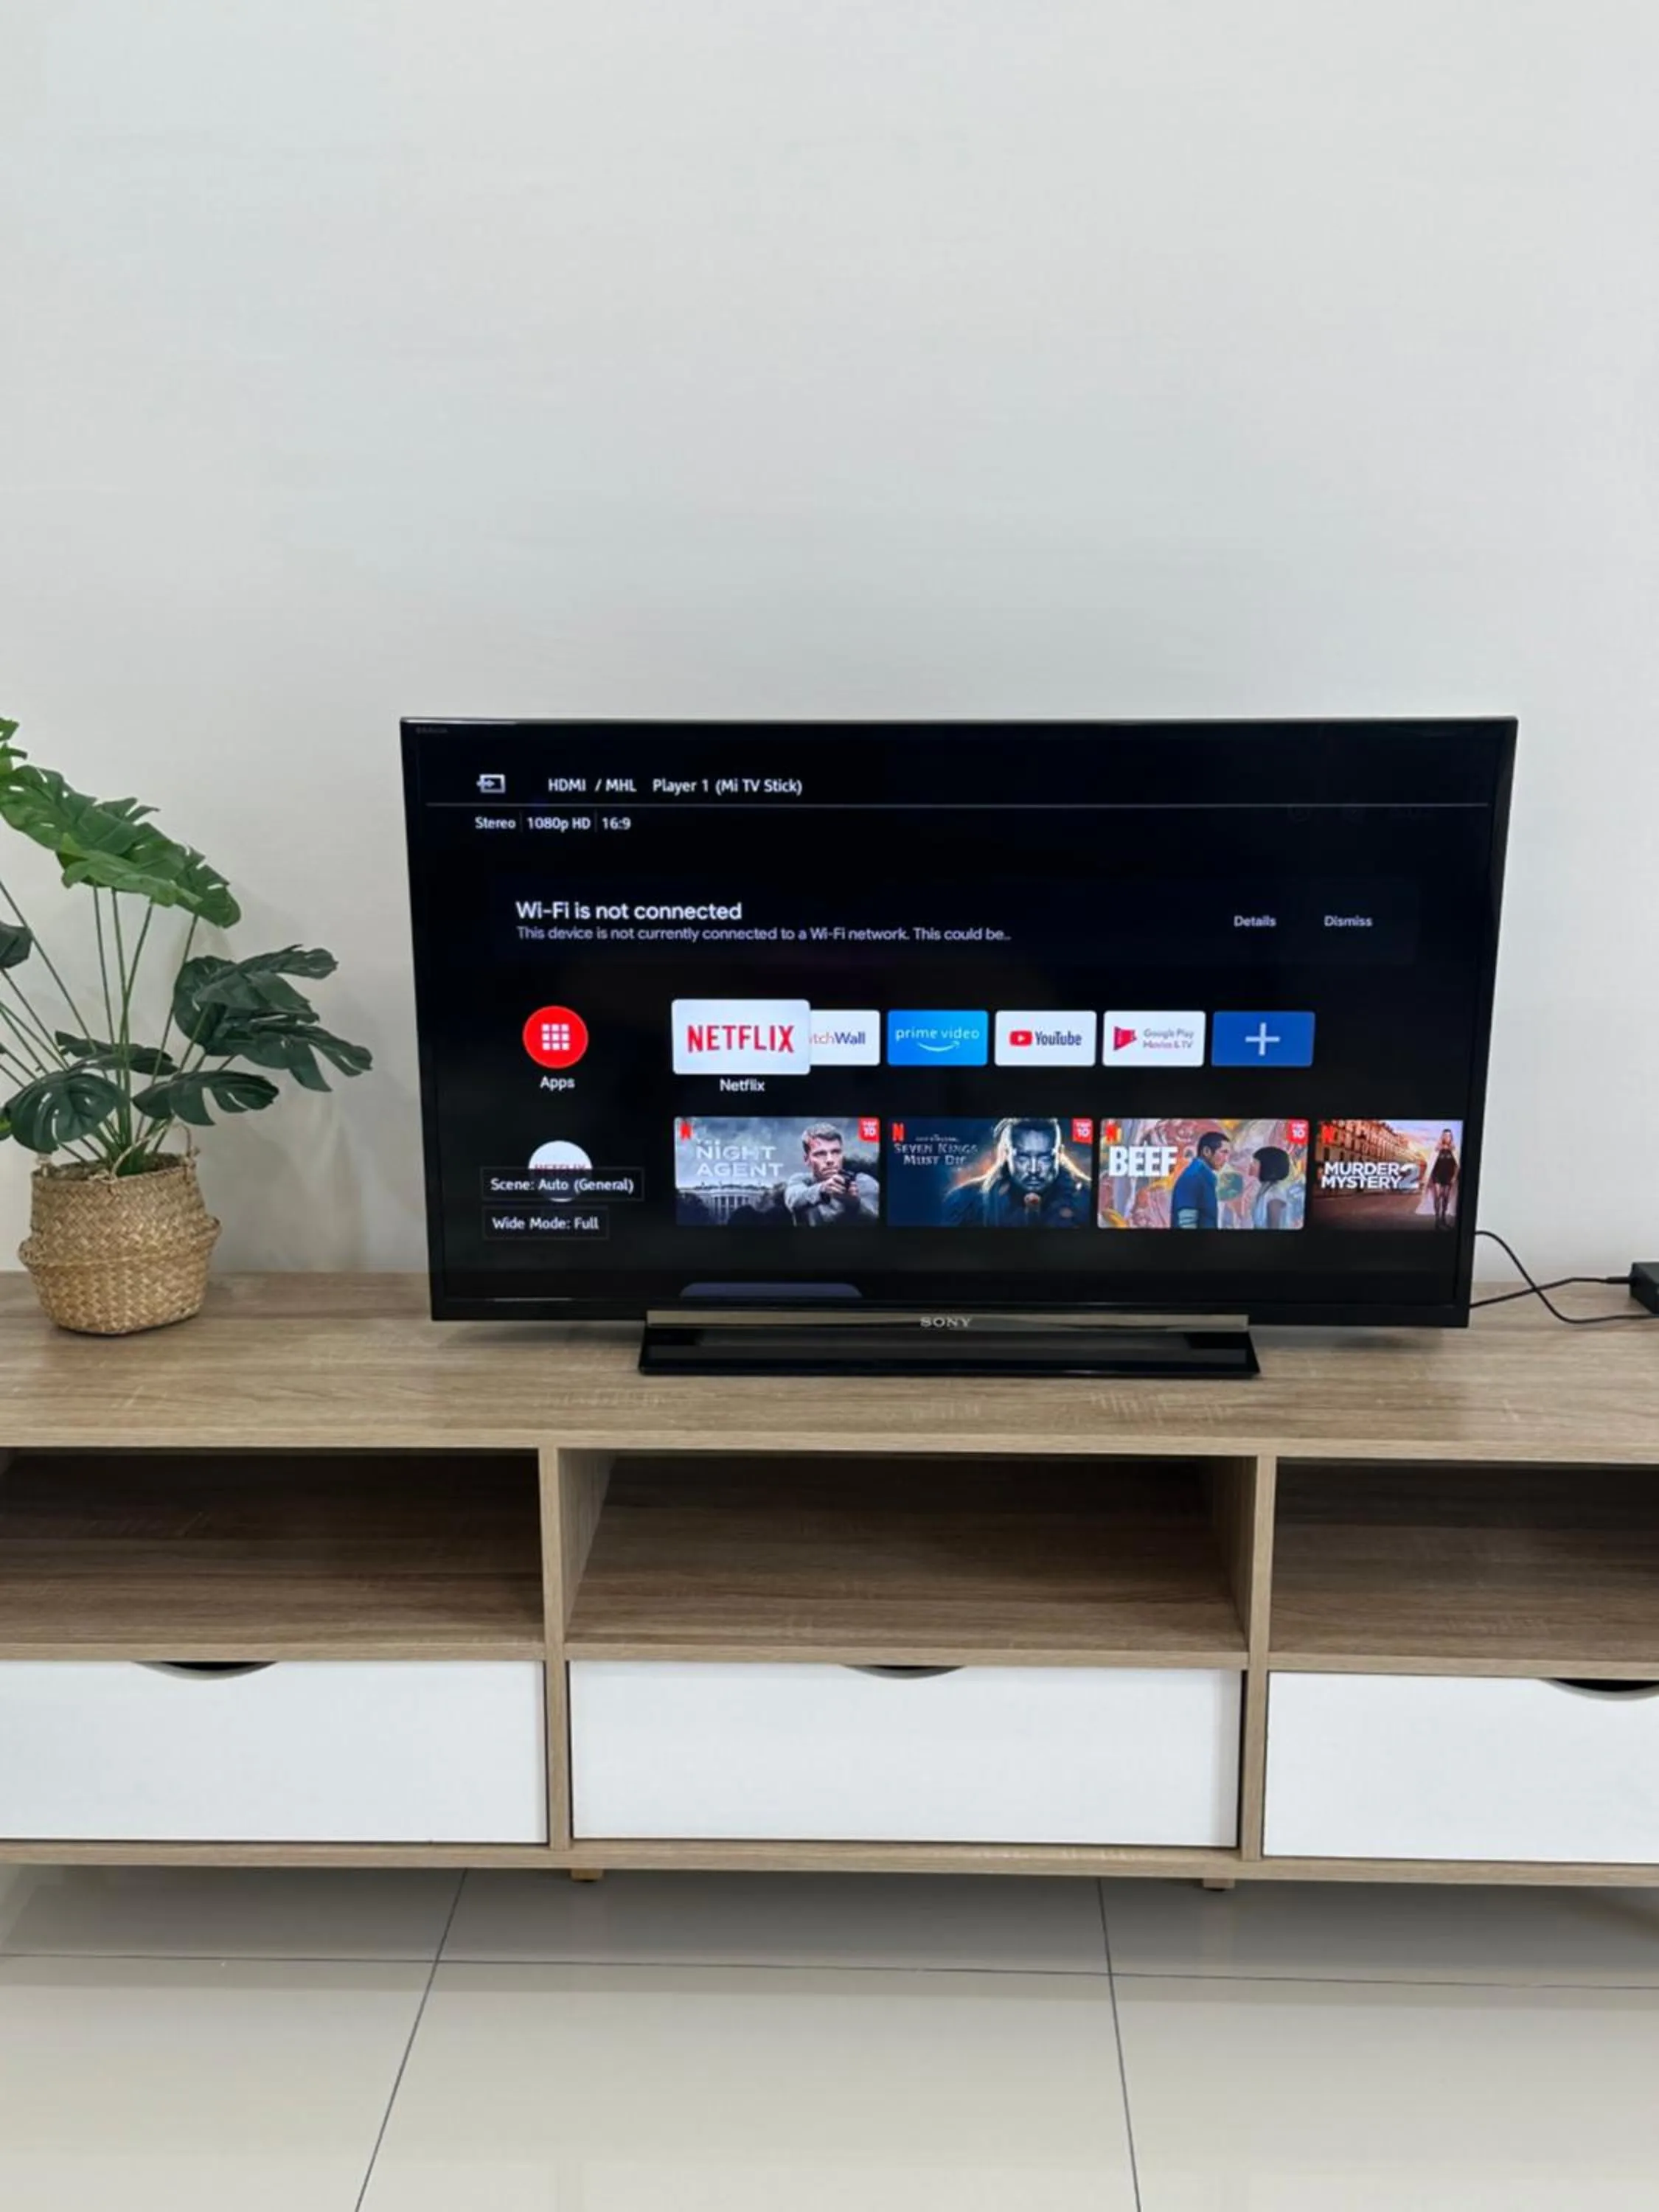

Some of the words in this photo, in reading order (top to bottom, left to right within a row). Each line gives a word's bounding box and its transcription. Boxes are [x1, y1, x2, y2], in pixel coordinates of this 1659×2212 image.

[548, 778, 586, 793] HDMI
[605, 779, 637, 793] MHL
[653, 779, 696, 796] Player
[702, 779, 709, 792] 1
[715, 779, 737, 796] (Mi
[742, 779, 759, 793] TV
[764, 779, 802, 795] Stick)
[475, 817, 516, 830] Stereo
[527, 817, 568, 832] 1080p
[571, 817, 591, 830] HD
[602, 817, 631, 830] 16:9
[515, 901, 569, 919] Wi-Fi
[574, 902, 591, 919] is
[595, 902, 629, 919] not
[633, 902, 742, 920] connected
[1234, 915, 1276, 927] Details
[1324, 915, 1373, 927] Dismiss
[518, 926, 545, 939] This
[548, 926, 593, 940] device
[597, 926, 608, 939] is
[611, 928, 635, 939] not
[637, 927, 699, 942] currently
[702, 927, 776, 941] connected
[781, 928, 795, 940] to
[798, 931, 807, 940] a
[810, 927, 846, 940] Wi-Fi
[848, 927, 910, 940] network.
[913, 927, 941, 940] This
[944, 927, 982, 940] could
[687, 1024, 795, 1053] NETFLIX
[808, 1032, 866, 1045] tchWall
[894, 1027, 939, 1041] prime
[942, 1027, 980, 1040] video
[1035, 1031, 1082, 1046] YouTube
[540, 1076, 575, 1091] Apps
[720, 1079, 765, 1093] Netflix
[695, 1144, 777, 1161] NIGHT
[894, 1143, 933, 1155] SEVEN
[903, 1155, 940, 1166] MUST
[1109, 1146, 1178, 1177] BEEF
[696, 1162, 784, 1178] AGENT
[1325, 1162, 1399, 1175] MURDER
[1321, 1176, 1401, 1189] MYSTERY
[1399, 1164, 1419, 1190] 2
[490, 1178, 535, 1191] Scene:
[538, 1179, 568, 1191] Auto
[574, 1178, 634, 1194] (General)
[492, 1217, 525, 1229] Wide
[529, 1217, 571, 1230] Mode:
[574, 1217, 599, 1229] Full
[919, 1316, 972, 1328] SONY
